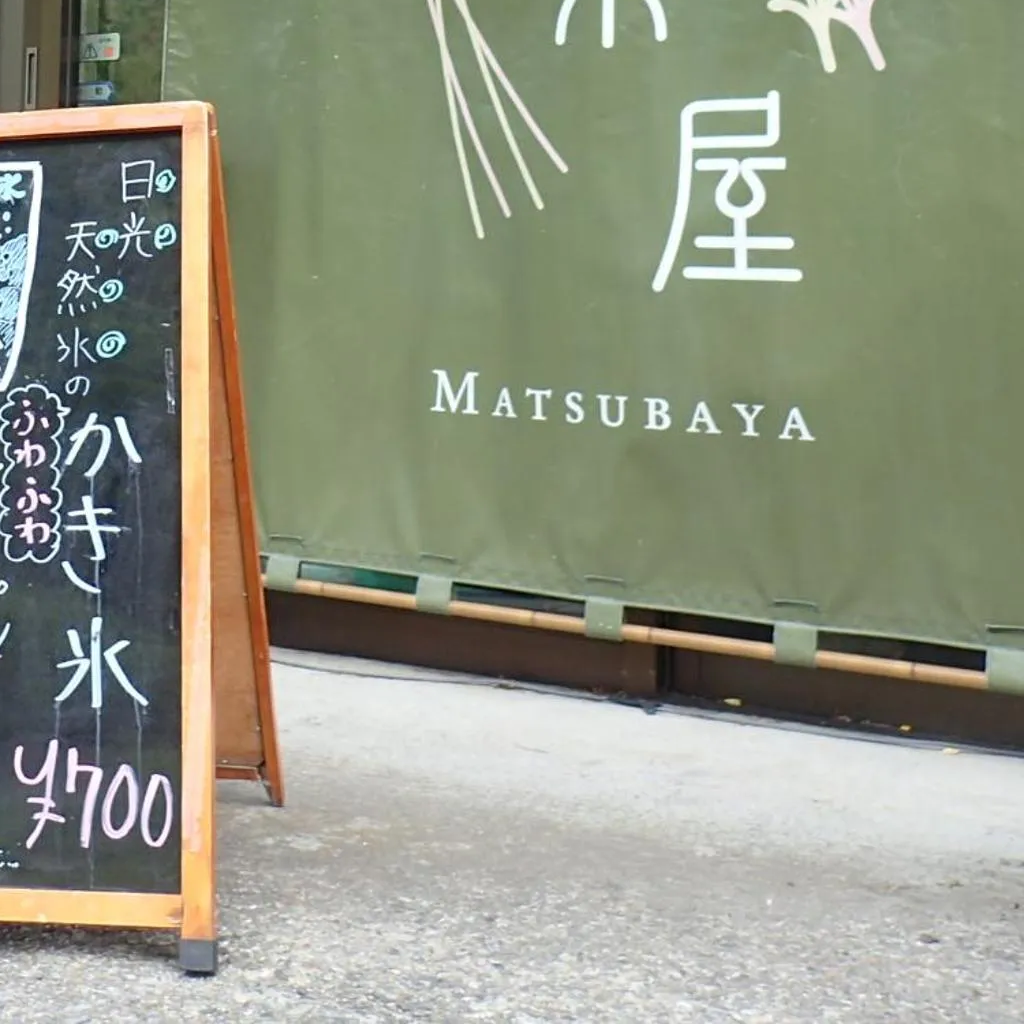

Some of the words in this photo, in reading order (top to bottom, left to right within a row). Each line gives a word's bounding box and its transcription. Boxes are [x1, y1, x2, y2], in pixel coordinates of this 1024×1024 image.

[430, 369, 816, 442] MATSUBAYA
[12, 401, 53, 544] ふわふわ
[14, 739, 174, 849] ¥700
